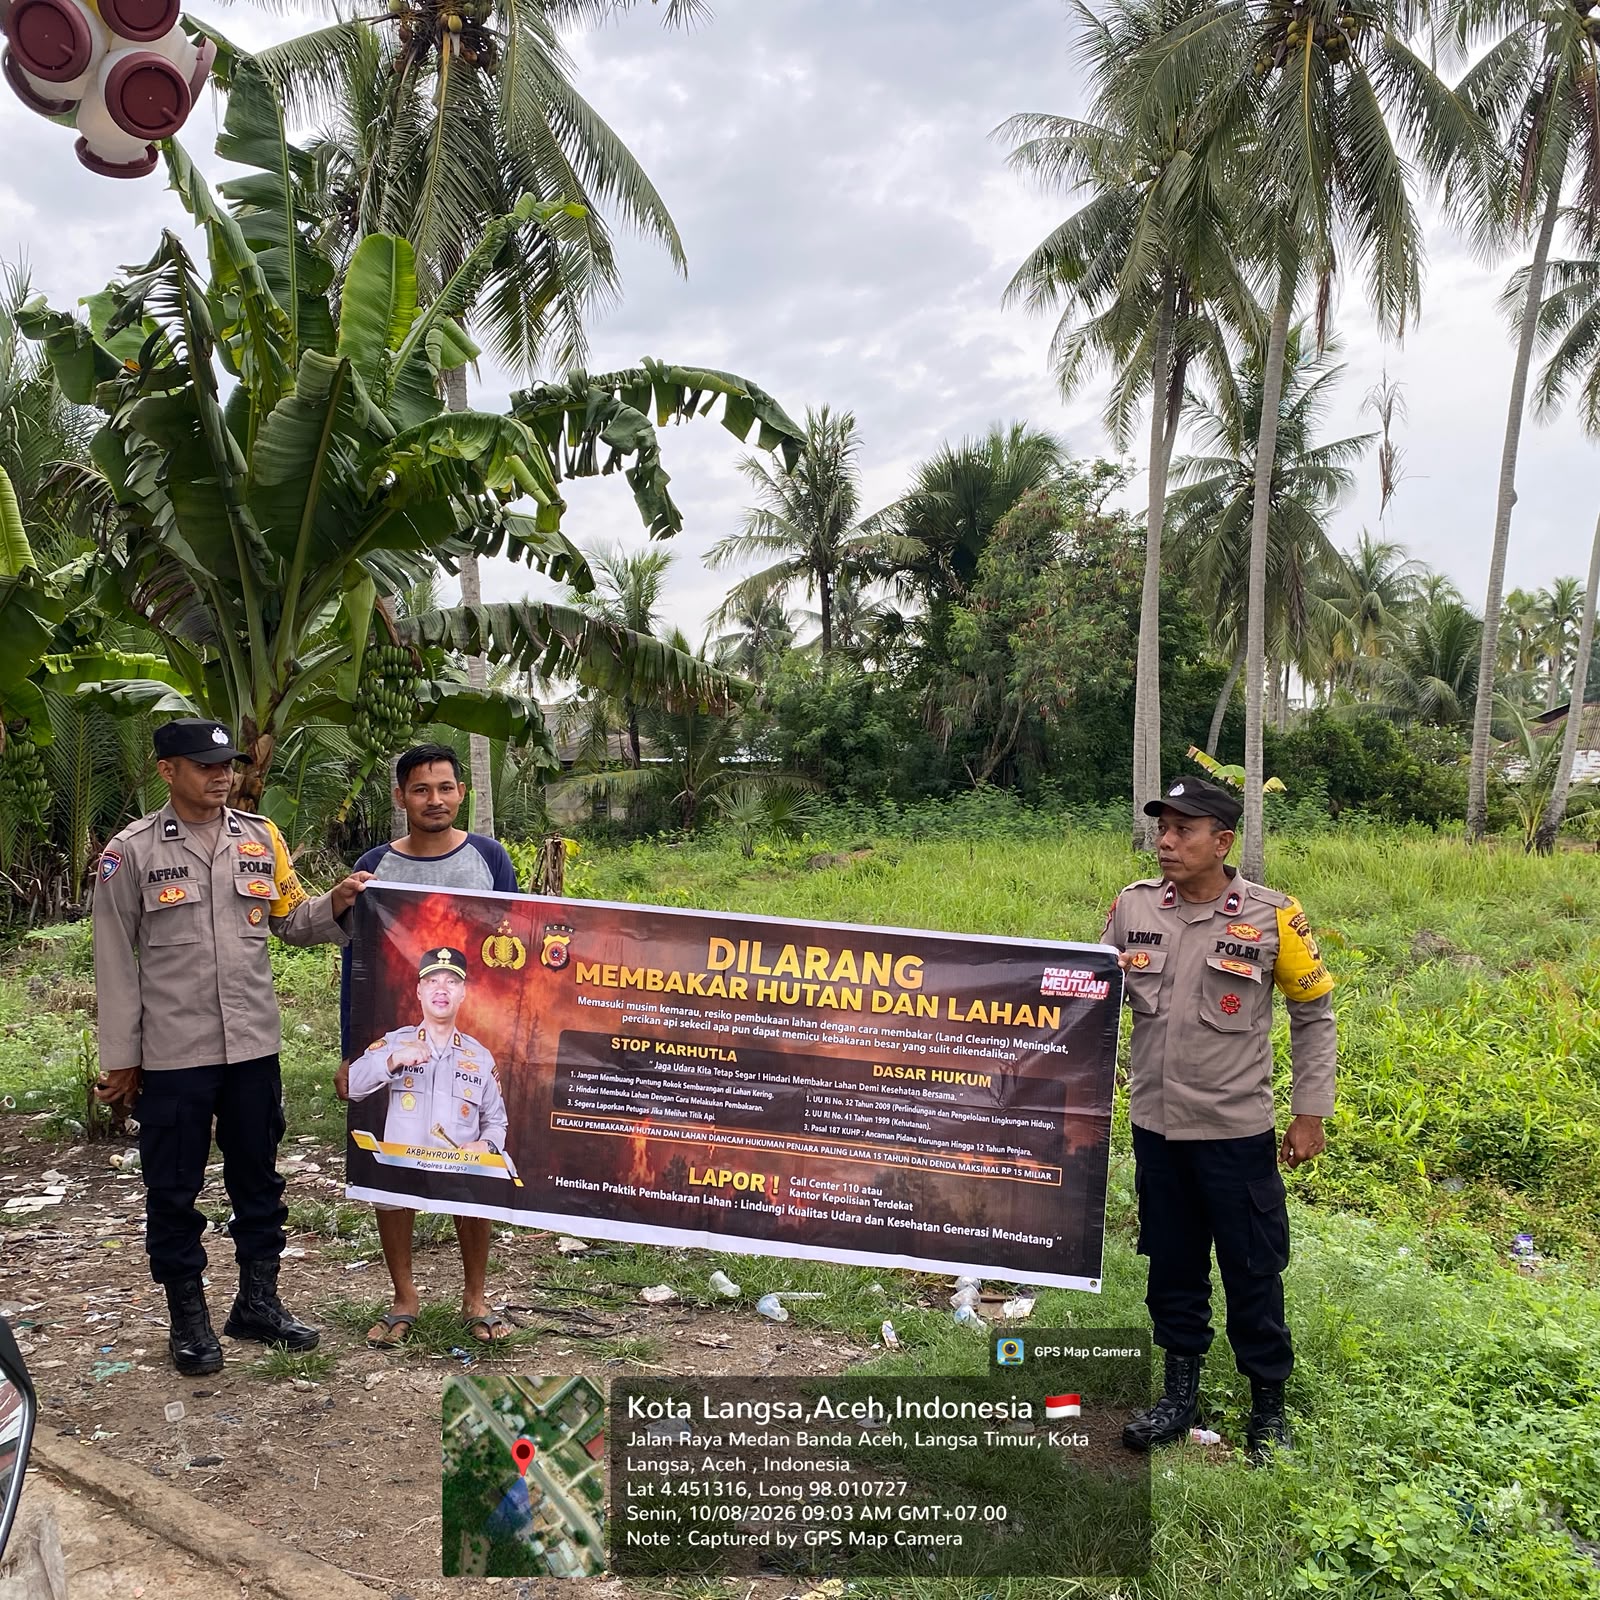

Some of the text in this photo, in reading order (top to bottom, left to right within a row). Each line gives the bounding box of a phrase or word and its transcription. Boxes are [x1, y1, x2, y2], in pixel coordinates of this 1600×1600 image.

[148, 866, 189, 883] AFFAN
[239, 861, 272, 875] POLRI
[545, 925, 574, 933] ACEH
[707, 937, 925, 989] DILARANG
[1214, 941, 1261, 960] POLRI
[1041, 976, 1108, 994] MEUTUAH
[1044, 967, 1093, 979] POLDA ACEH
[575, 962, 1061, 1030] MEMBAKAR HUTAN DAN LAHAN
[577, 995, 1069, 1055] Memasuki musim kemarau, resiko pembukaan lahan dengan cara membakar (Land Clearing) Meningkat,
[622, 1014, 1018, 1061] percikan api sekecil apa pun dapat memicu kebakaran besar yang sulit dikendalikan.
[611, 1037, 738, 1063] STOP KARHUTLA
[455, 1072, 482, 1086] POLRI
[576, 1071, 775, 1101] Jangan Membuang Puntung Rokok Sembarangan Lahan Kering.
[654, 1061, 958, 1102] Jaga Udara Kita Tetap Segar Hindari Membakar Lahan Demi Kesehatan Bersama.
[873, 1064, 992, 1088] DASAR HUKUM
[845, 1098, 854, 1107] 32
[854, 1099, 874, 1109] Tahun
[874, 1101, 891, 1111] 2009
[891, 1103, 937, 1117] (Perlindungan
[936, 1108, 950, 1118] dan
[950, 1110, 990, 1123] Pengelolaan
[991, 1115, 1030, 1128] Lingkungan
[556, 1118, 1052, 1181] PELAKU PEMBAKARAN HUTAN DAN LAHAN DIANCAM HUKUMAN PENJARA PALING LAMA 15 TAHUN DAN DENDA MAKSIMAL RP 15 MILIAR
[810, 1124, 828, 1133] Pasal
[828, 1126, 841, 1134] 187
[841, 1127, 861, 1136] KUHP
[864, 1129, 895, 1140] Ancaman
[895, 1133, 917, 1143] Pidana
[918, 1135, 950, 1148] Kurungan
[950, 1140, 975, 1152] Hingga
[985, 1144, 1006, 1153] Tahun
[417, 1160, 468, 1172] Kapolres Langsa
[688, 1166, 766, 1193] LAPOR
[790, 1176, 883, 1196] Call Center 110 atau
[555, 1176, 1054, 1249] Hentikan Praktik Pembakaran Lahan Lindungi Kualitas Udara dan Kesehatan Generasi Mendatang
[789, 1187, 914, 1212] Kantor Kepolisian Terdekat
